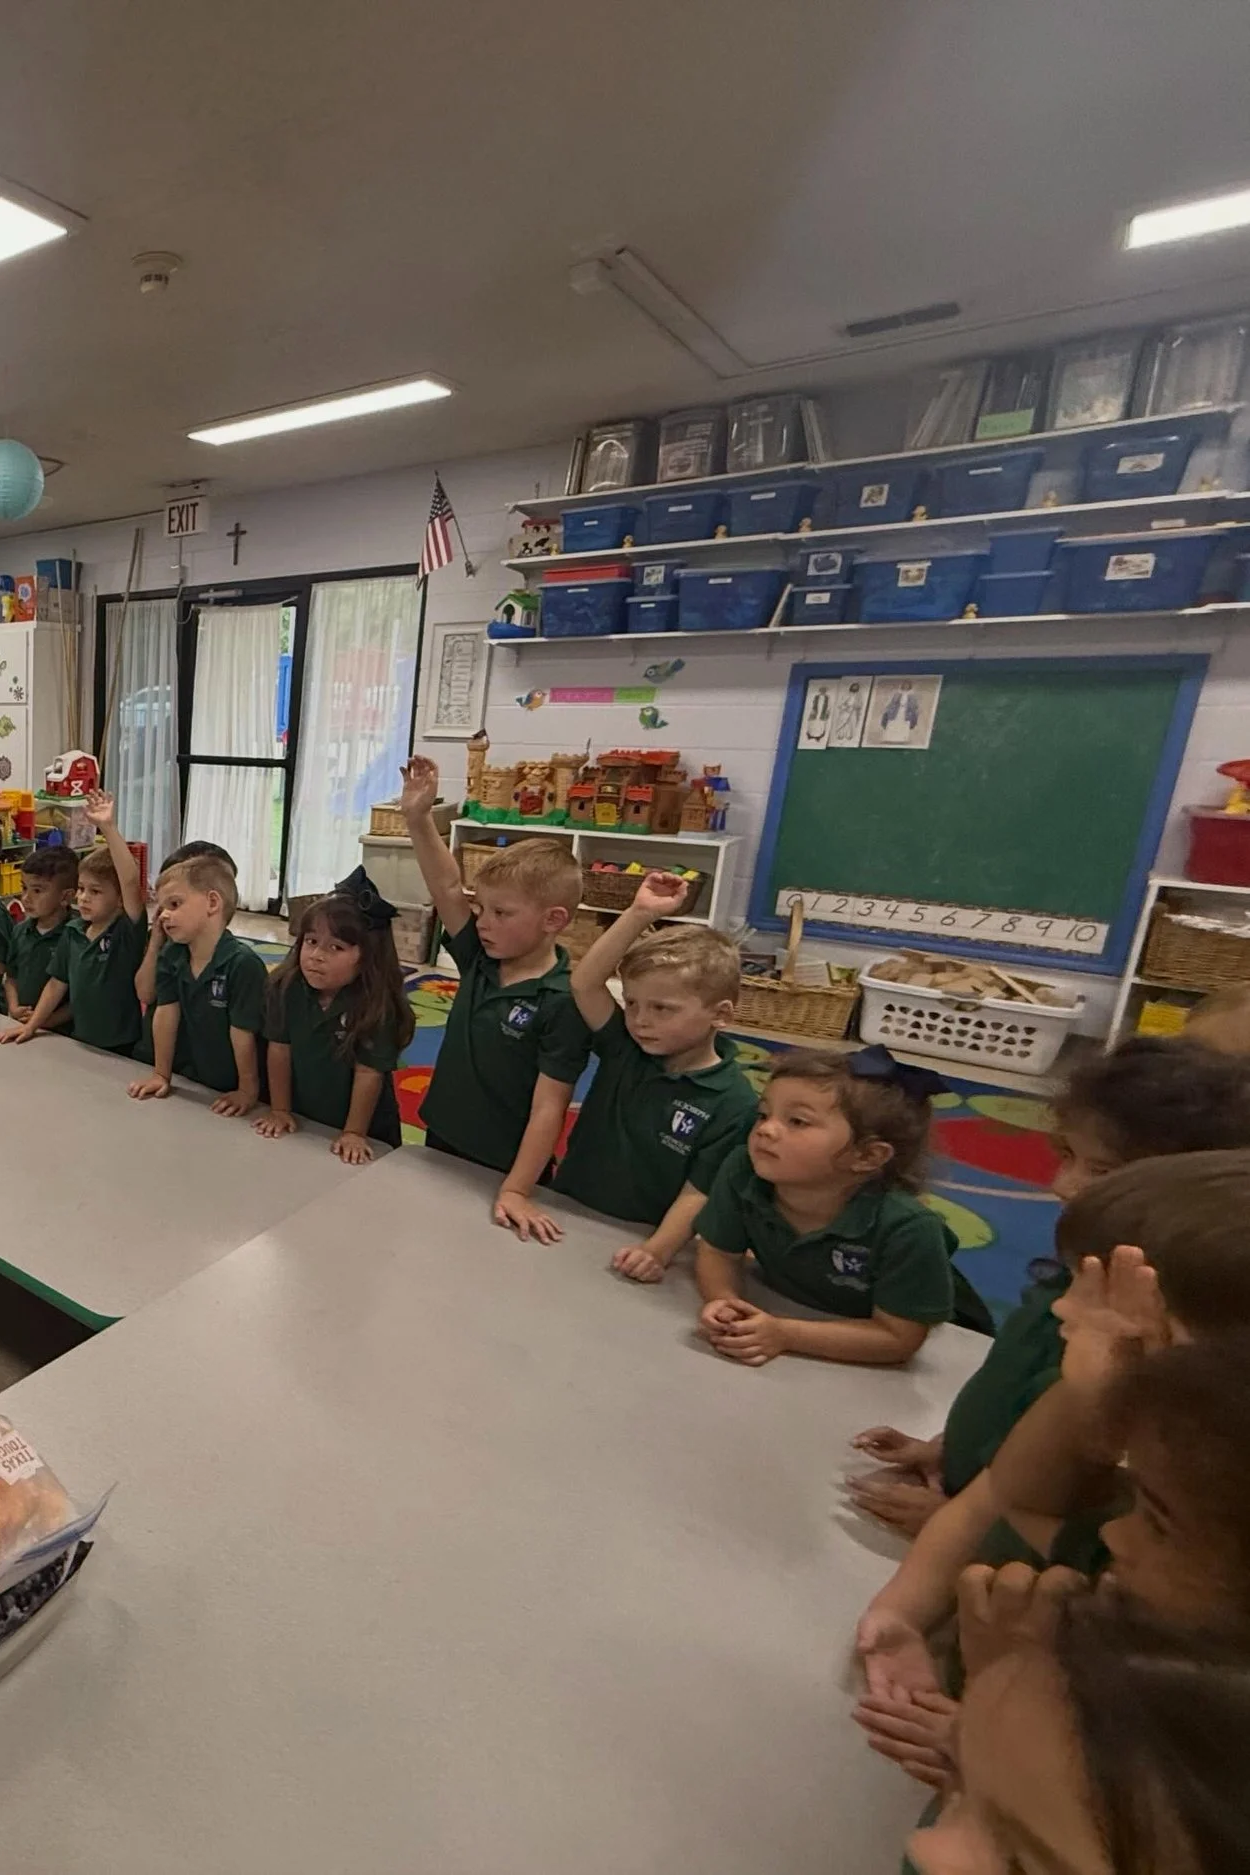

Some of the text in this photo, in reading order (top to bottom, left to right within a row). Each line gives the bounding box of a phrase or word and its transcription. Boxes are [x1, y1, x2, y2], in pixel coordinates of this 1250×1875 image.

[168, 502, 199, 534] EXIT
[810, 896, 821, 911] 1
[831, 898, 849, 914] 2
[857, 901, 875, 917] 3
[883, 903, 899, 920] 4
[909, 907, 929, 923] 5
[939, 911, 956, 927] 6
[970, 913, 991, 929] 7
[1001, 916, 1022, 933] 8
[1035, 919, 1051, 938] 9
[1065, 923, 1097, 941] 10
[1, 1449, 34, 1473] TEXAS
